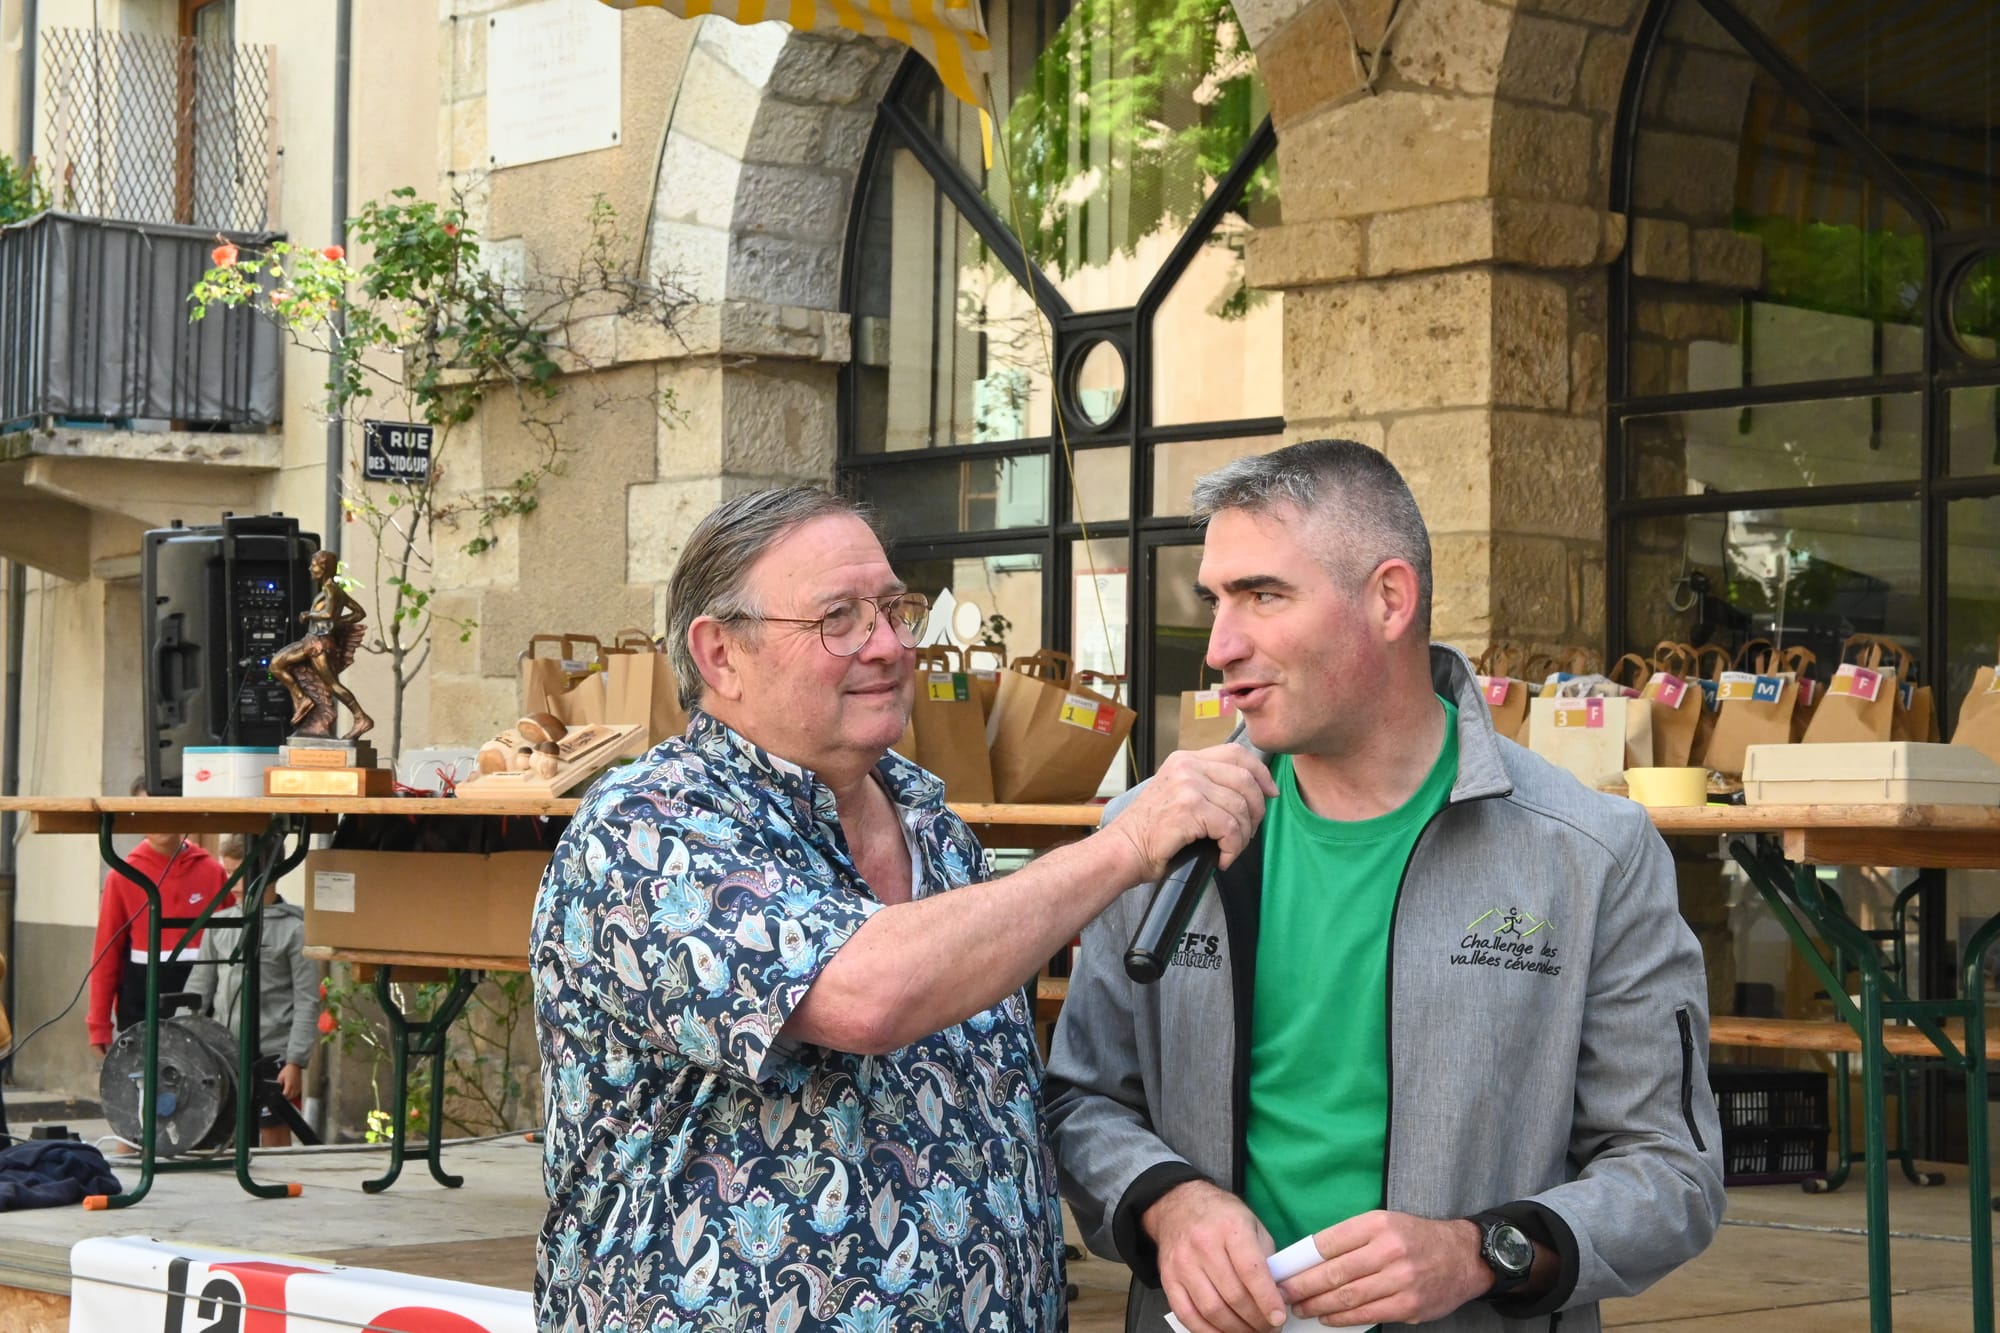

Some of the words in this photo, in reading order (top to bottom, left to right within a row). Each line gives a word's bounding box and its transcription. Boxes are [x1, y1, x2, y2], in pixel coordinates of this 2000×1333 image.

[390, 430, 429, 450] RUE
[368, 455, 386, 470] DES
[1663, 683, 1677, 697] F
[1720, 682, 1732, 698] 3
[1757, 682, 1776, 696] M
[1858, 676, 1870, 690] F
[931, 684, 940, 698] 1
[1491, 685, 1502, 698] F
[1065, 706, 1075, 721] 1
[1557, 710, 1568, 727] 3
[1591, 706, 1600, 721] F
[1460, 933, 1534, 957] Challenge
[1450, 950, 1502, 967] vallées
